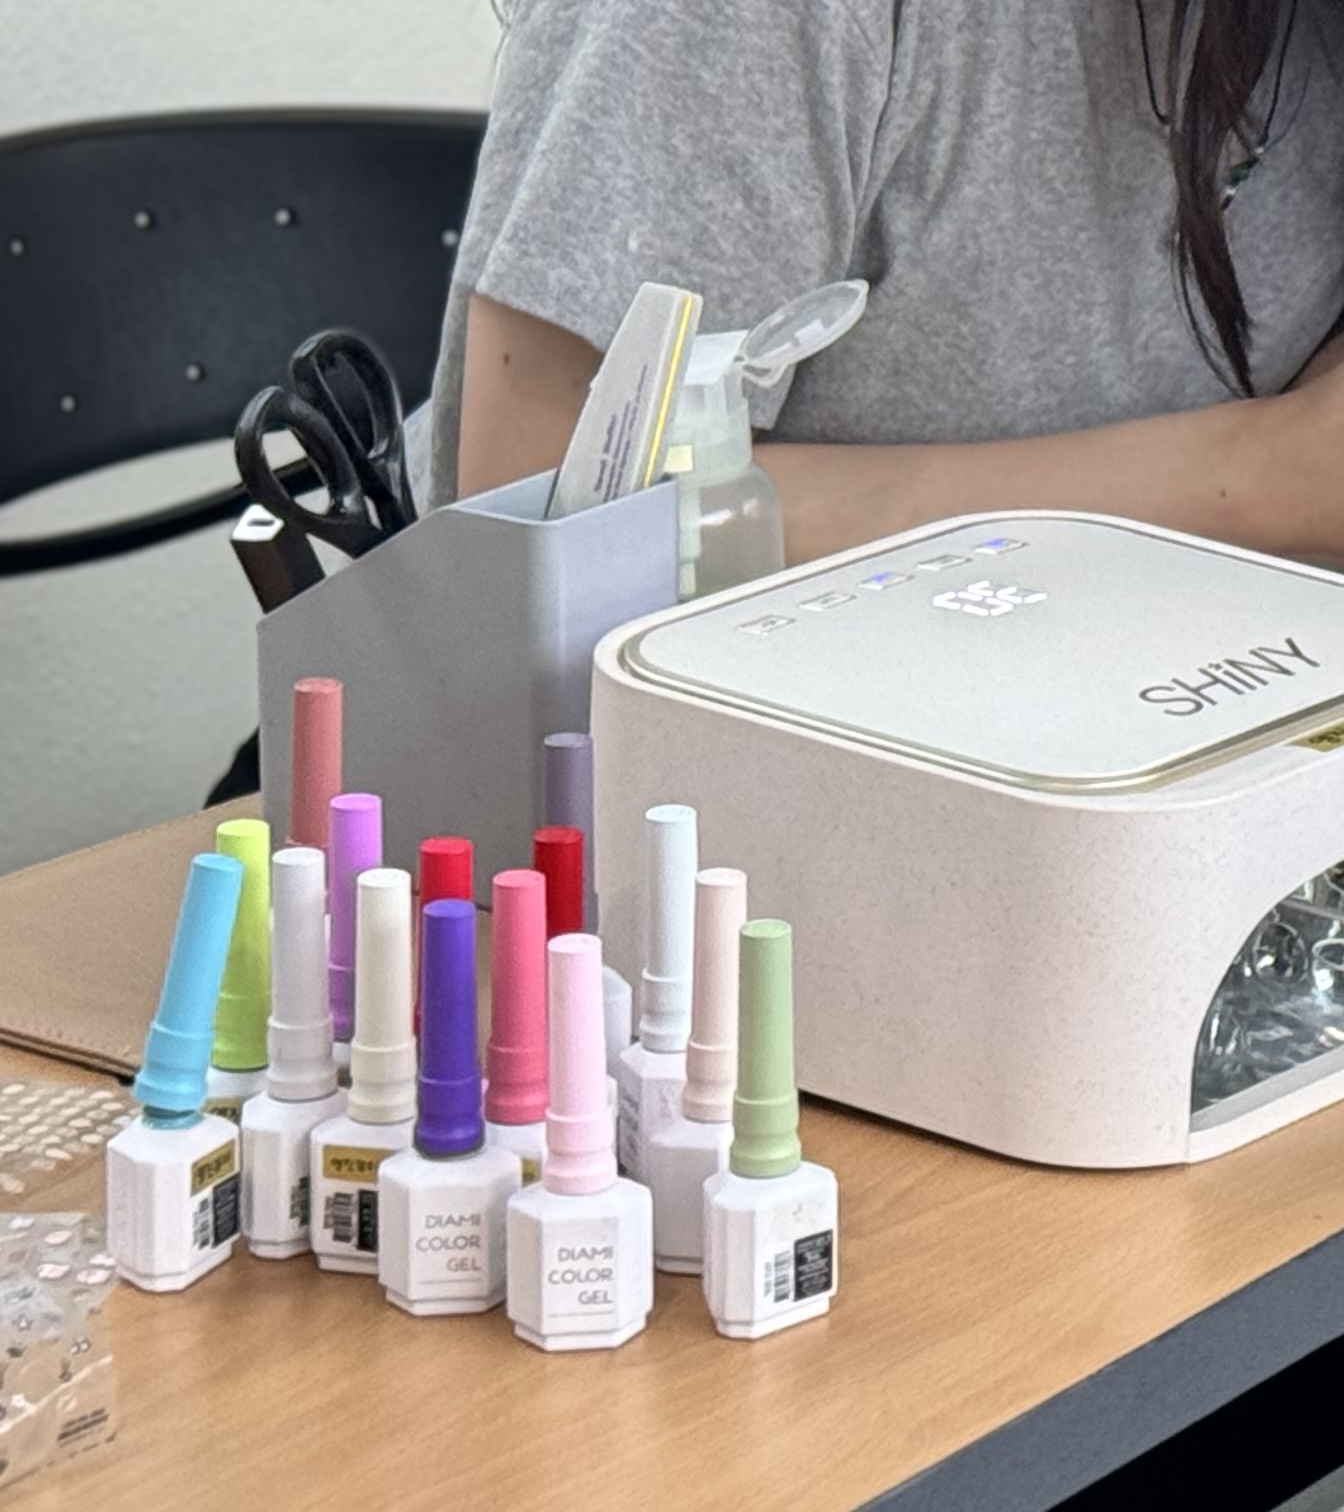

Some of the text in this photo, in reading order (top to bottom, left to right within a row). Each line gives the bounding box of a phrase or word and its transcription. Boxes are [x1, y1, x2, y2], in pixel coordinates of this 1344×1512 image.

[425, 1214, 481, 1229] DIAMI
[415, 1235, 481, 1252] COLOR
[558, 1246, 614, 1262] DIAMI
[446, 1257, 482, 1272] GEL
[547, 1268, 614, 1285] COLOR
[578, 1290, 614, 1305] GEL
